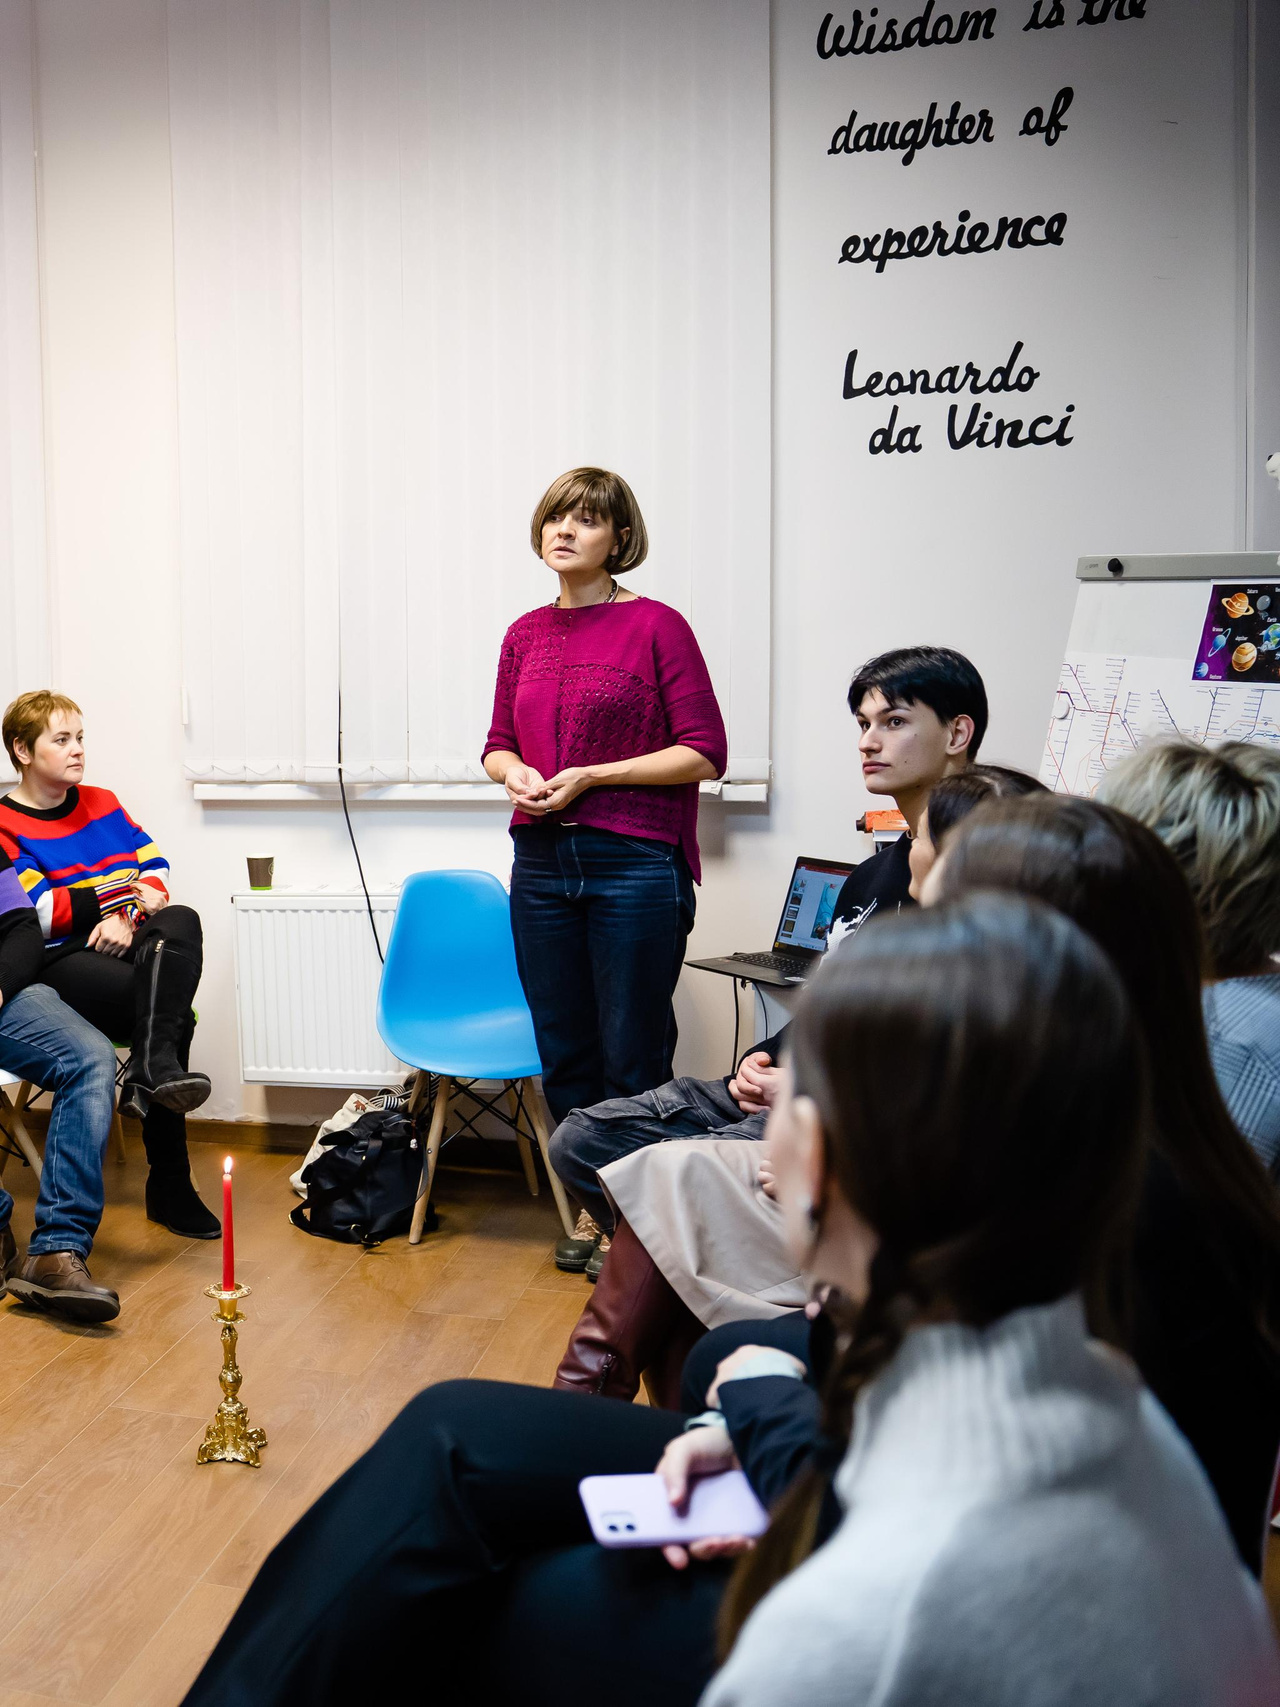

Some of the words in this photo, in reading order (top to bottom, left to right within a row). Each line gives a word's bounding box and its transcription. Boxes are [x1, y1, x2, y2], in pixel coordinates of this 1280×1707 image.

[817, 0, 997, 59] Wisdom
[1022, 0, 1066, 32] is
[827, 101, 995, 166] daughter
[1019, 87, 1075, 147] of
[838, 210, 1068, 273] experience
[843, 341, 1040, 399] Leonardo
[869, 405, 922, 455] da
[947, 402, 1076, 450] Vinci
